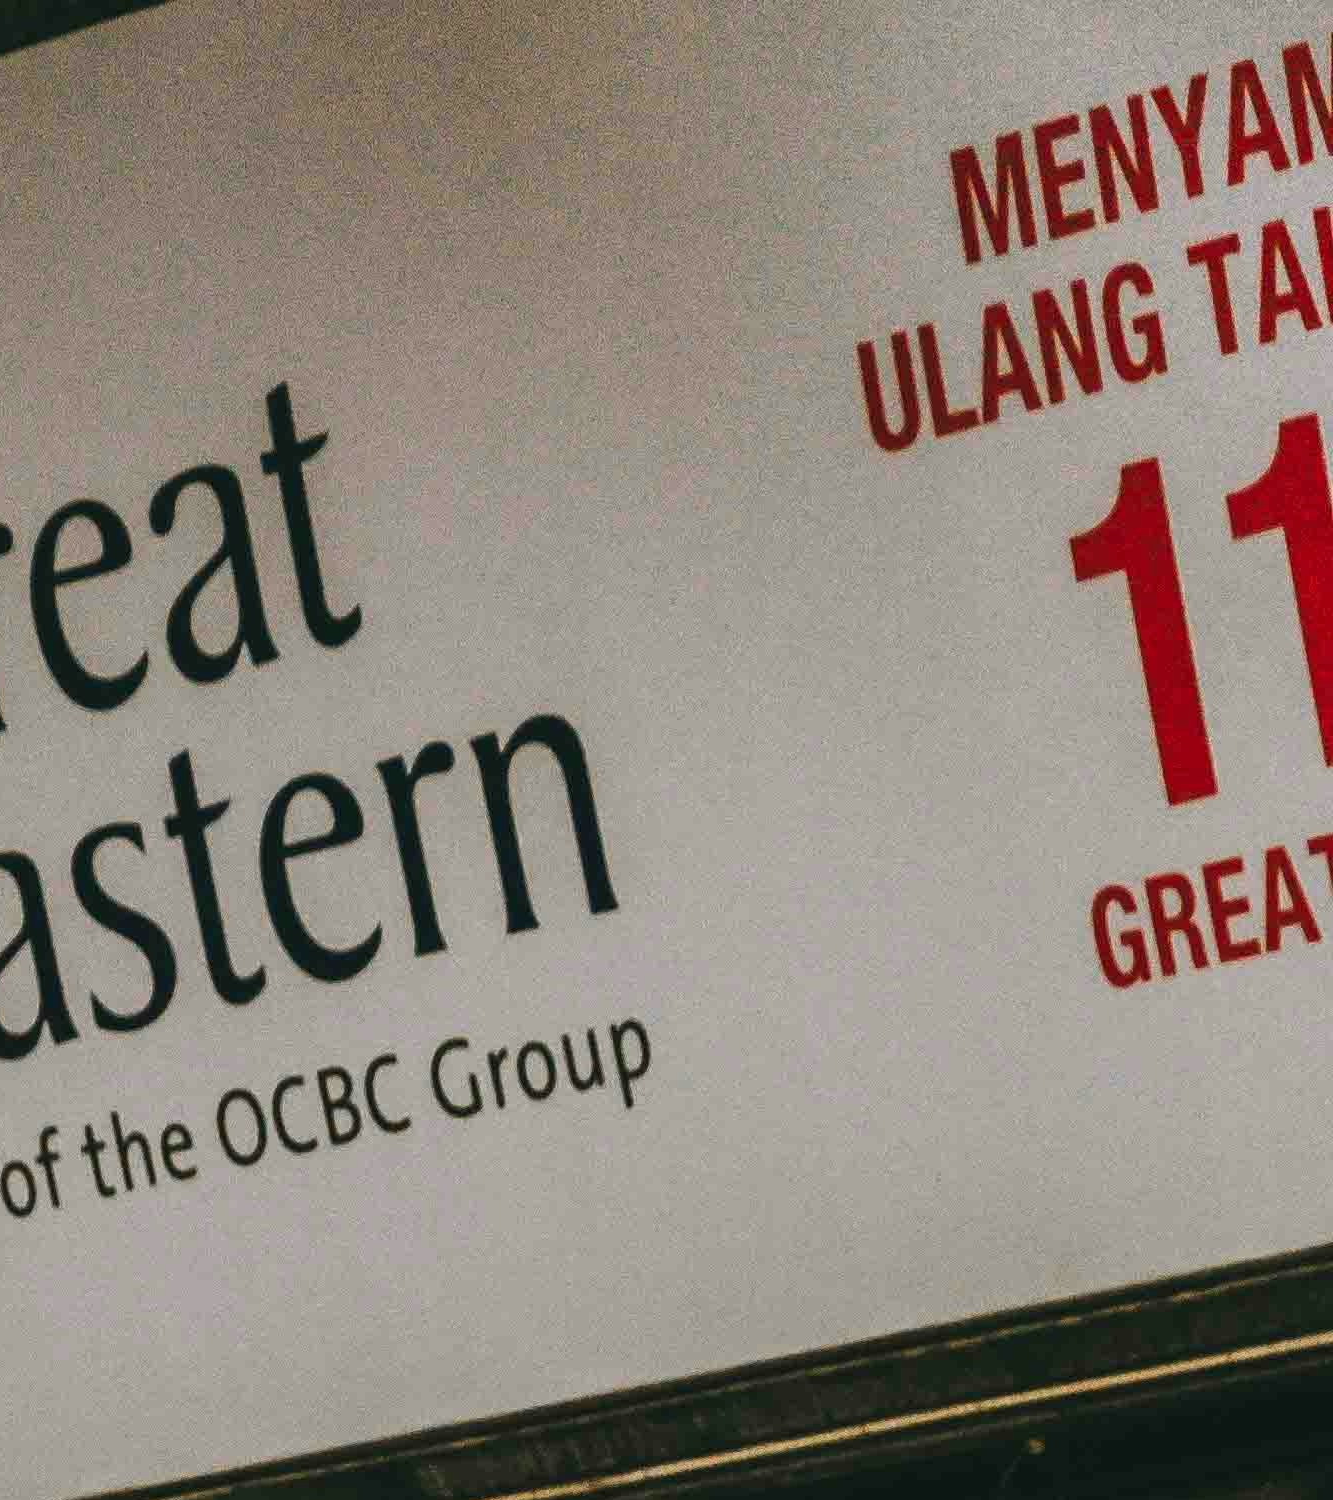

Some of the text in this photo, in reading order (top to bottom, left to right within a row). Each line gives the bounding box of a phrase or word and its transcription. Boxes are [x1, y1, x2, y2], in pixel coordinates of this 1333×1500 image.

[860, 264, 1168, 450] ULANG
[1, 1126, 63, 1218] of
[82, 1113, 196, 1197] the
[216, 1055, 410, 1166] OCBC
[431, 1020, 651, 1118] Group
